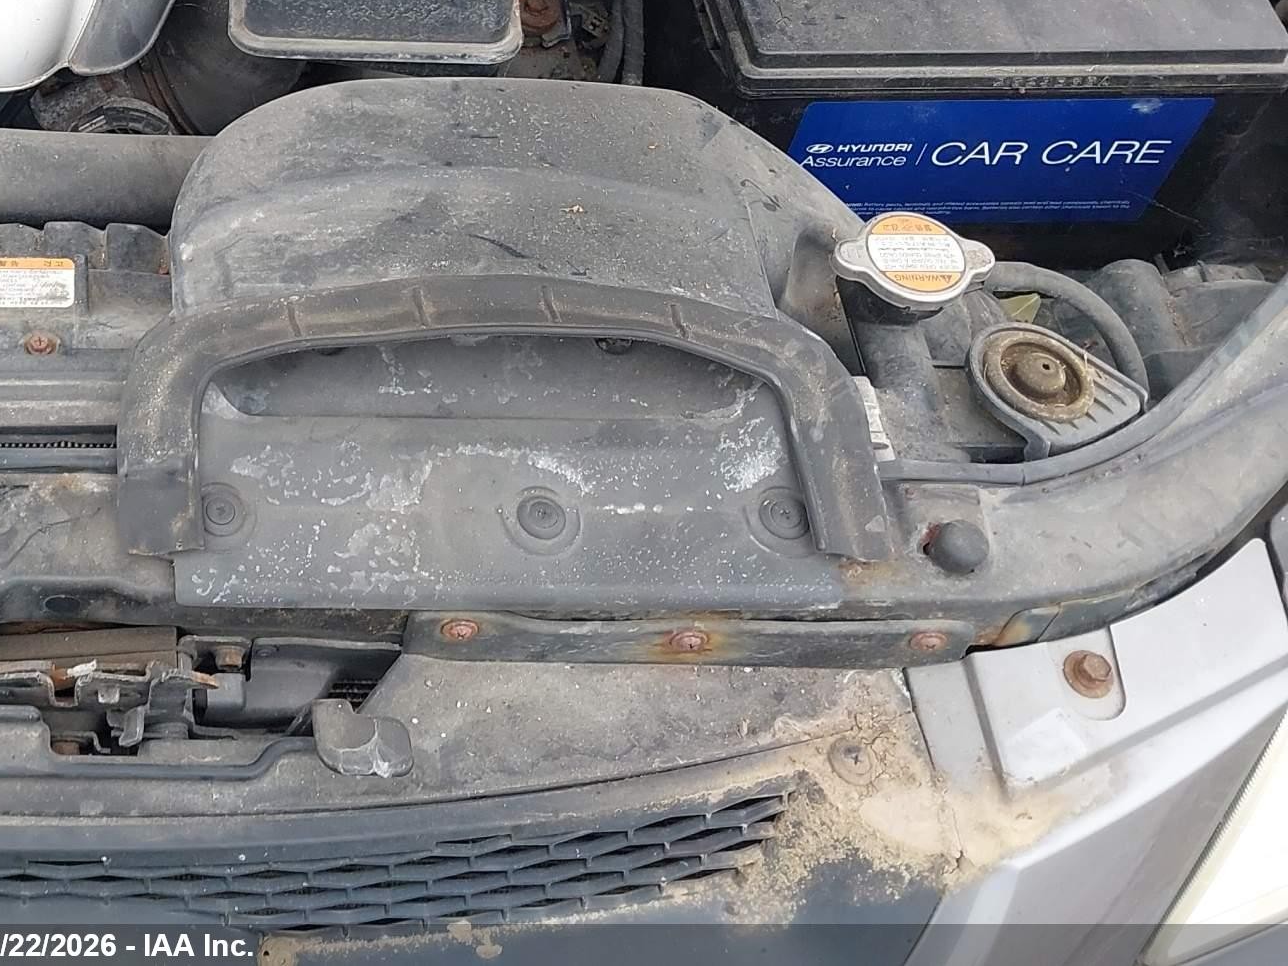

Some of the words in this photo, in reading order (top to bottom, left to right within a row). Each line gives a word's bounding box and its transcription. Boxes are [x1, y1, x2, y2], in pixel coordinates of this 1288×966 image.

[799, 152, 907, 167] Assurance
[837, 143, 913, 153] HYUNDAI
[931, 140, 1029, 166] CAR
[1041, 139, 1172, 165] CARE
[894, 274, 942, 283] WARNING
